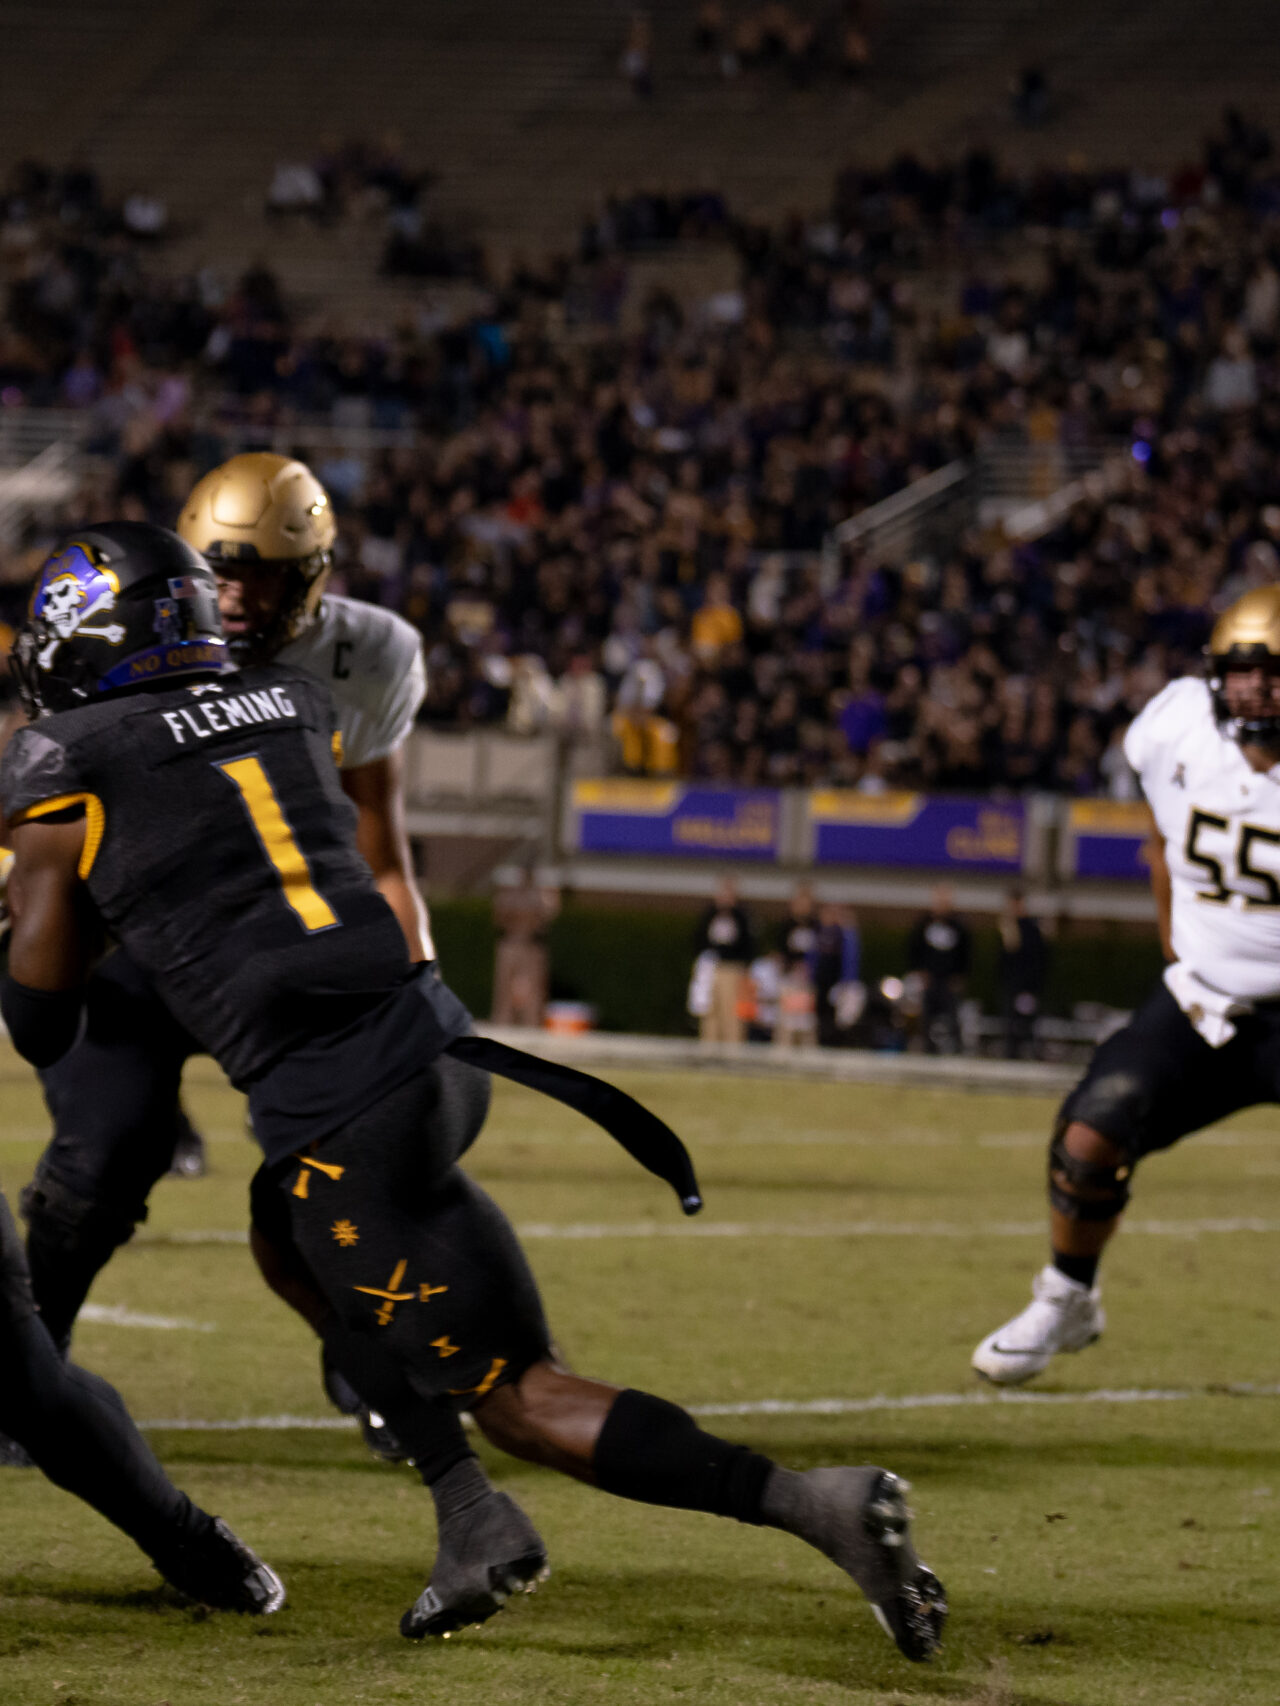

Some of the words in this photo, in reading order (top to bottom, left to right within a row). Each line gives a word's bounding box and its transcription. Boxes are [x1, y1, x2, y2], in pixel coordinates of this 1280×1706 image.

[333, 641, 353, 679] C
[162, 686, 297, 744] FLEMING
[209, 752, 344, 935] 1
[1184, 803, 1280, 912] 55
